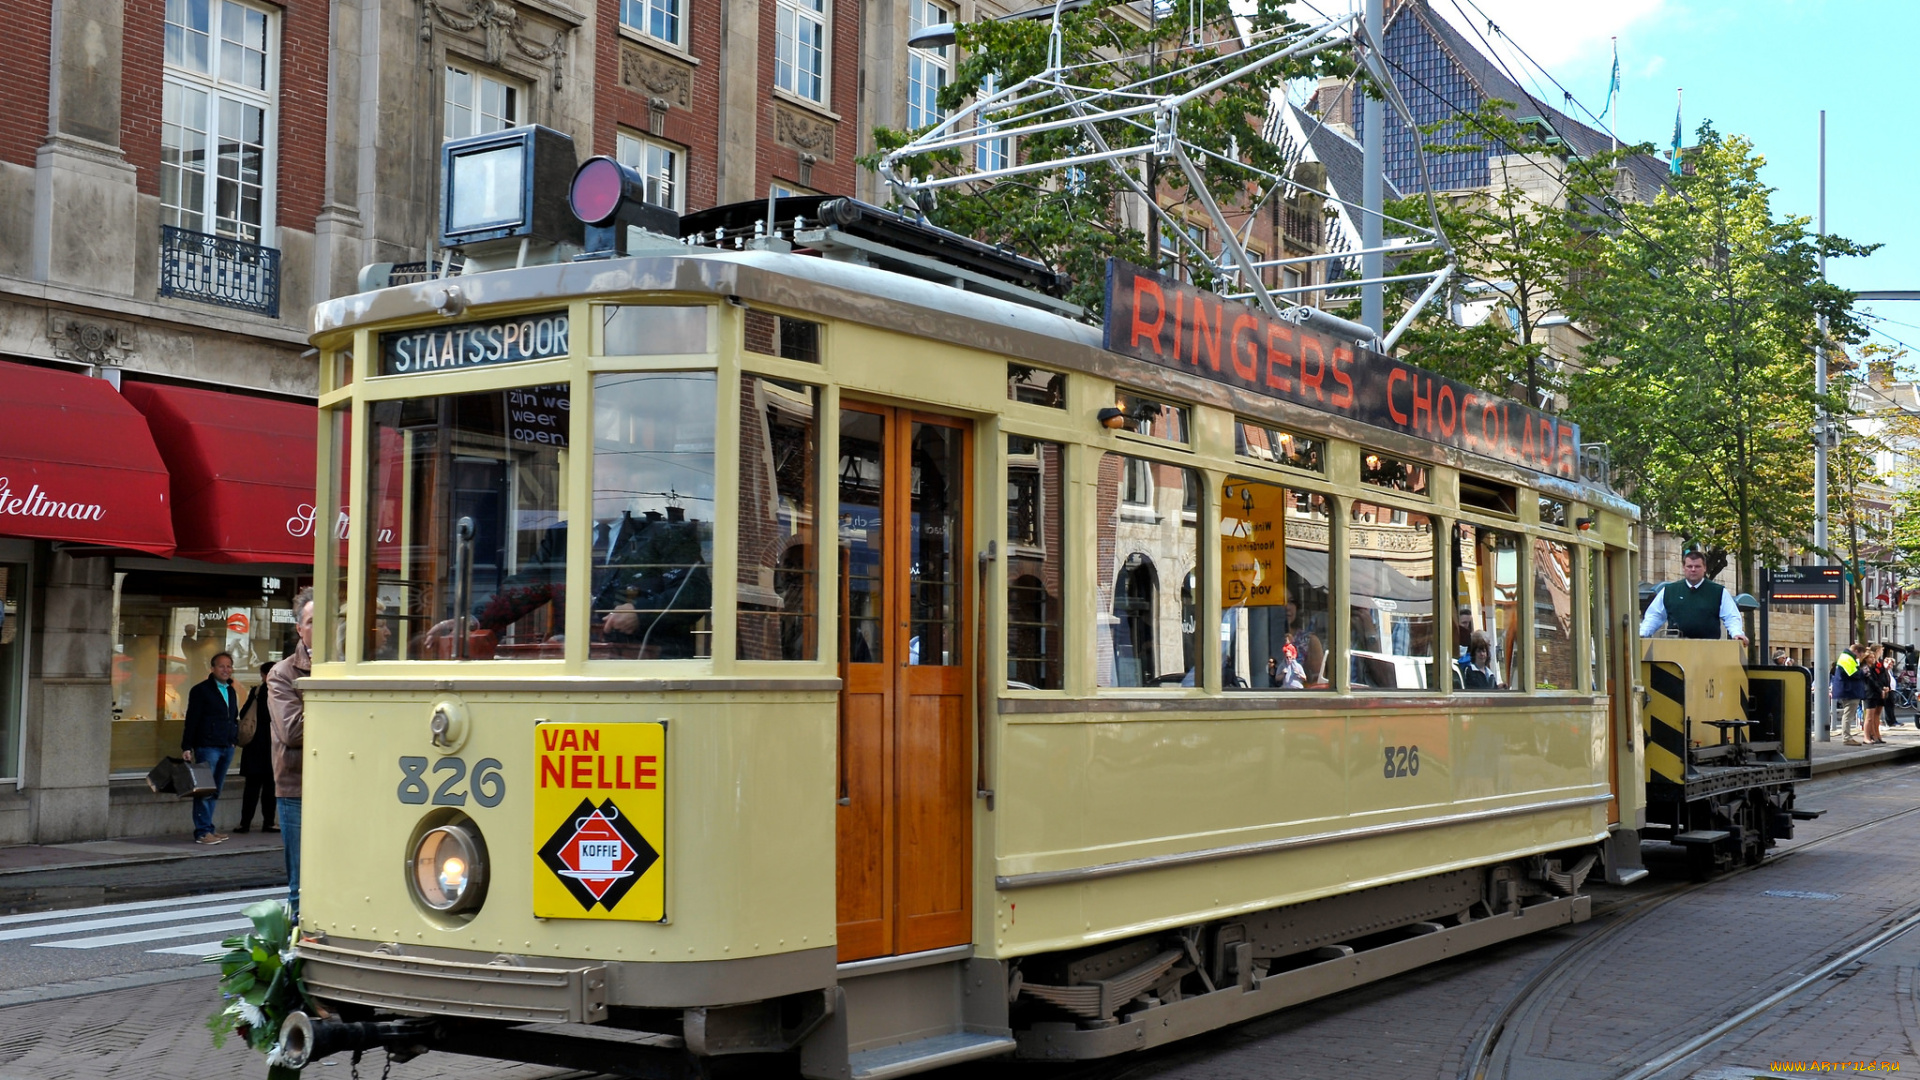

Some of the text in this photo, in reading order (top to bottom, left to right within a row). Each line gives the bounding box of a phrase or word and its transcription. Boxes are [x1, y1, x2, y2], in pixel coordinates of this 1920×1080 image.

[396, 316, 569, 372] STAATSSPOOR
[1130, 275, 1574, 474] RINGERS CHOCOLADE
[510, 389, 538, 408] zijn
[512, 410, 557, 427] weer
[514, 428, 568, 446] open.
[542, 729, 600, 751] VAN
[541, 755, 657, 789] NELLE
[1384, 745, 1419, 779] 826
[397, 756, 506, 808] 826
[582, 844, 618, 857] KOFFIE
